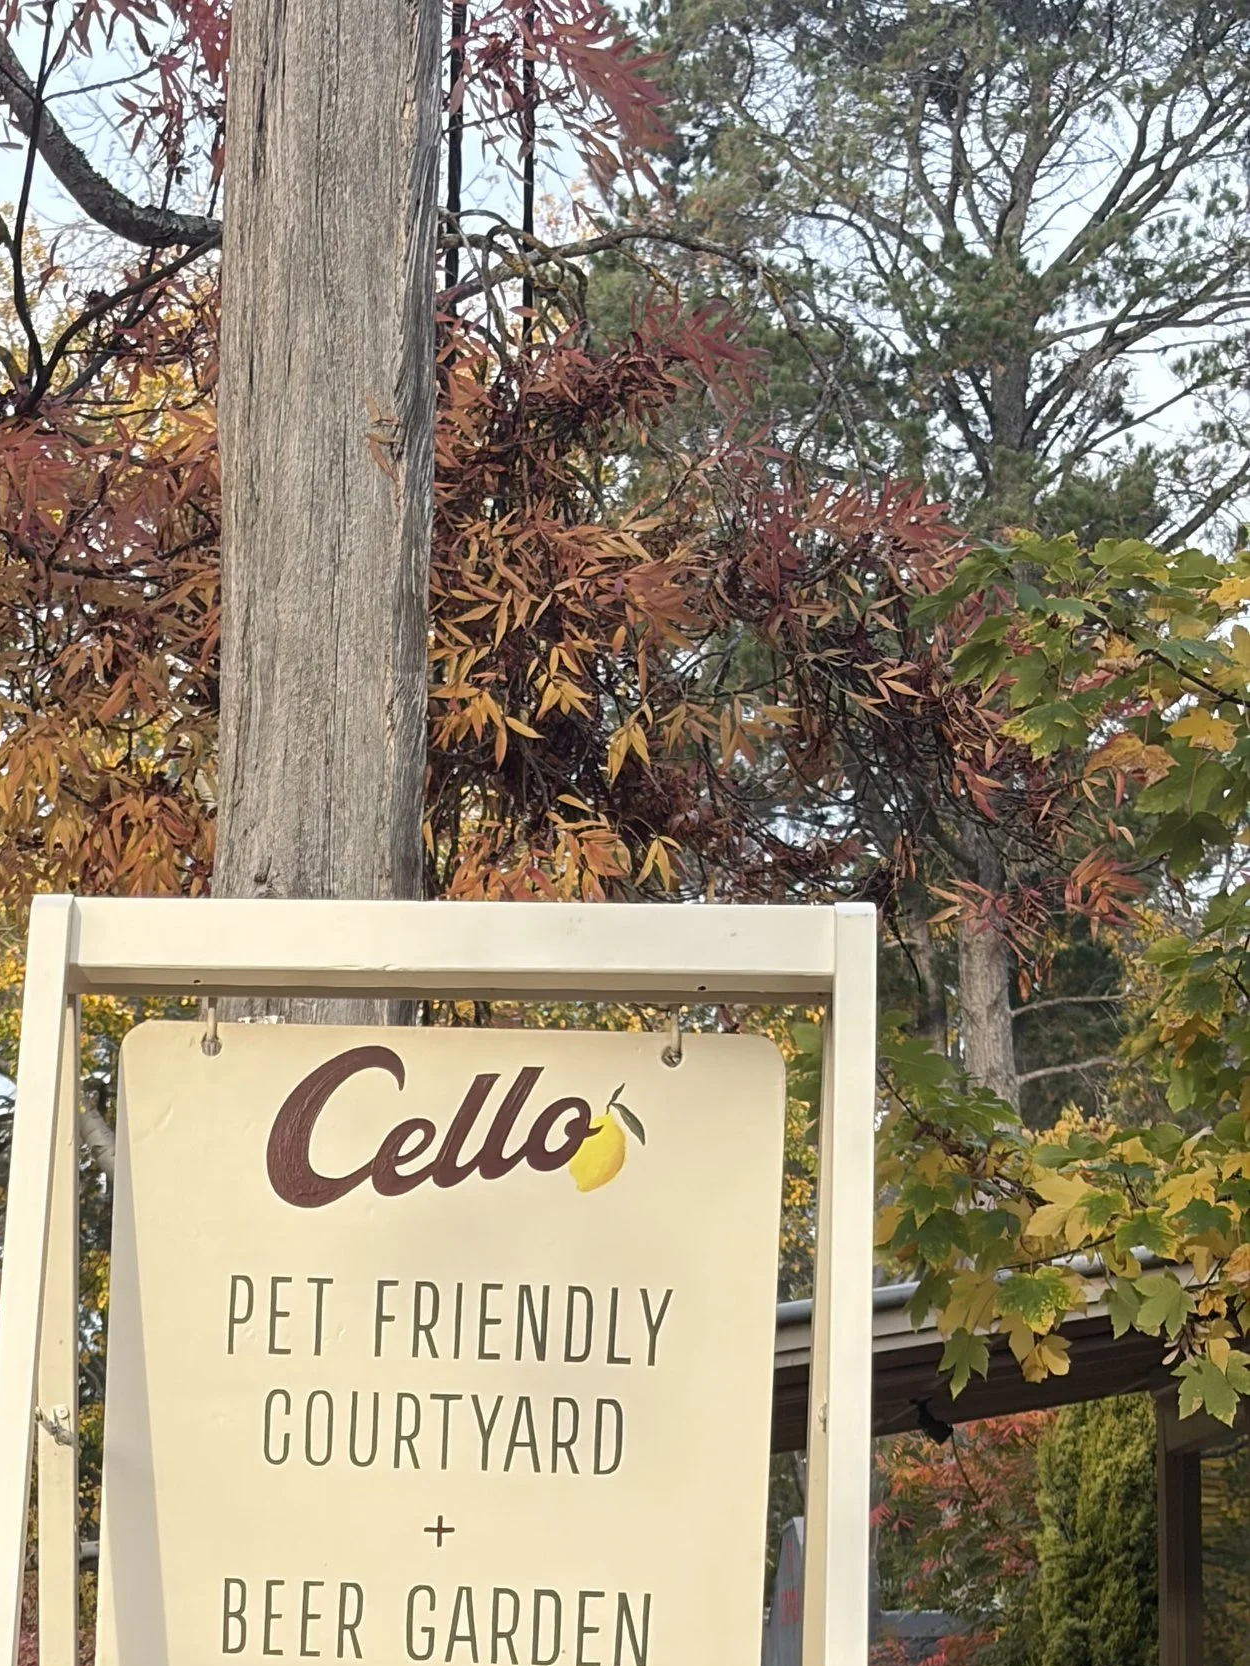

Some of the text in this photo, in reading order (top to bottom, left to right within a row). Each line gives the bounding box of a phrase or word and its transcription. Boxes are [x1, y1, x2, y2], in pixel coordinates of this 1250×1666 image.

[266, 1044, 602, 1209] Cello
[227, 1275, 674, 1367] PET FRIENDLY
[263, 1388, 625, 1476] COURTYARD
[222, 1577, 365, 1660] BEER
